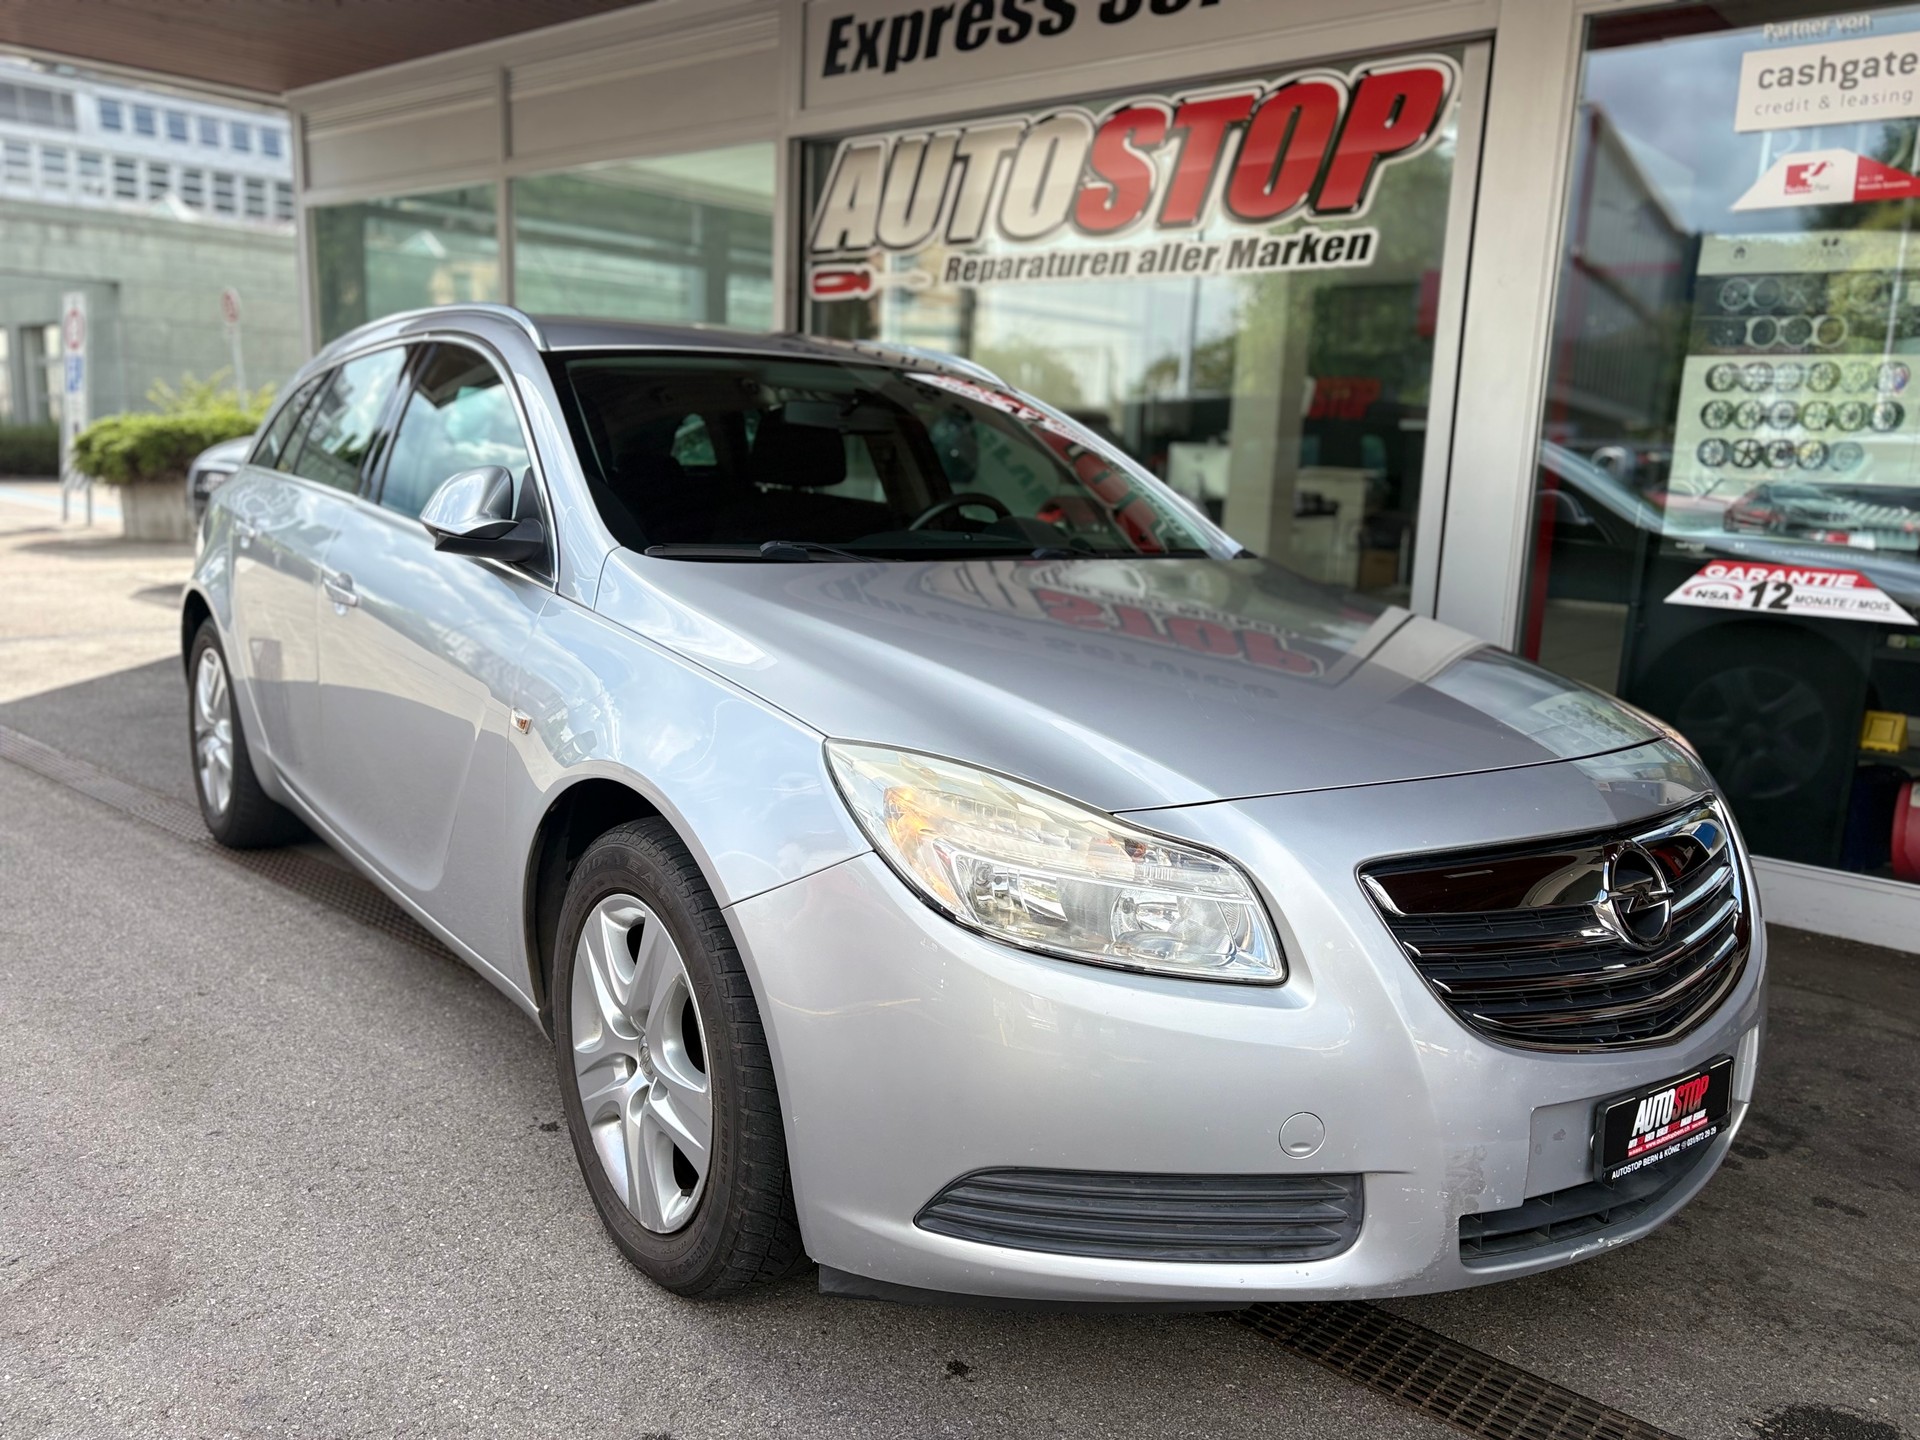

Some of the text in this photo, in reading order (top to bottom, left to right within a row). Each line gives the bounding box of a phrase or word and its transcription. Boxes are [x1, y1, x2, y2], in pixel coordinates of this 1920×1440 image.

[822, 0, 1078, 78] Express
[1762, 13, 1873, 41] Partner von
[1757, 50, 1919, 90] cashgate
[1754, 89, 1914, 116] credit & leasing
[808, 58, 1456, 256] AUTOSTOP
[944, 232, 1373, 284] Reparaturen aller Marken
[1704, 564, 1859, 588] GARANTIE
[1695, 589, 1730, 601] NSA
[1749, 580, 1794, 611] 12
[1793, 594, 1847, 608] MONATE
[1857, 600, 1891, 612] MOIS
[1631, 1074, 1710, 1137] AUTOSTOP
[1611, 1160, 1643, 1180] AUTOSTOP
[1642, 1153, 1660, 1167] BERN
